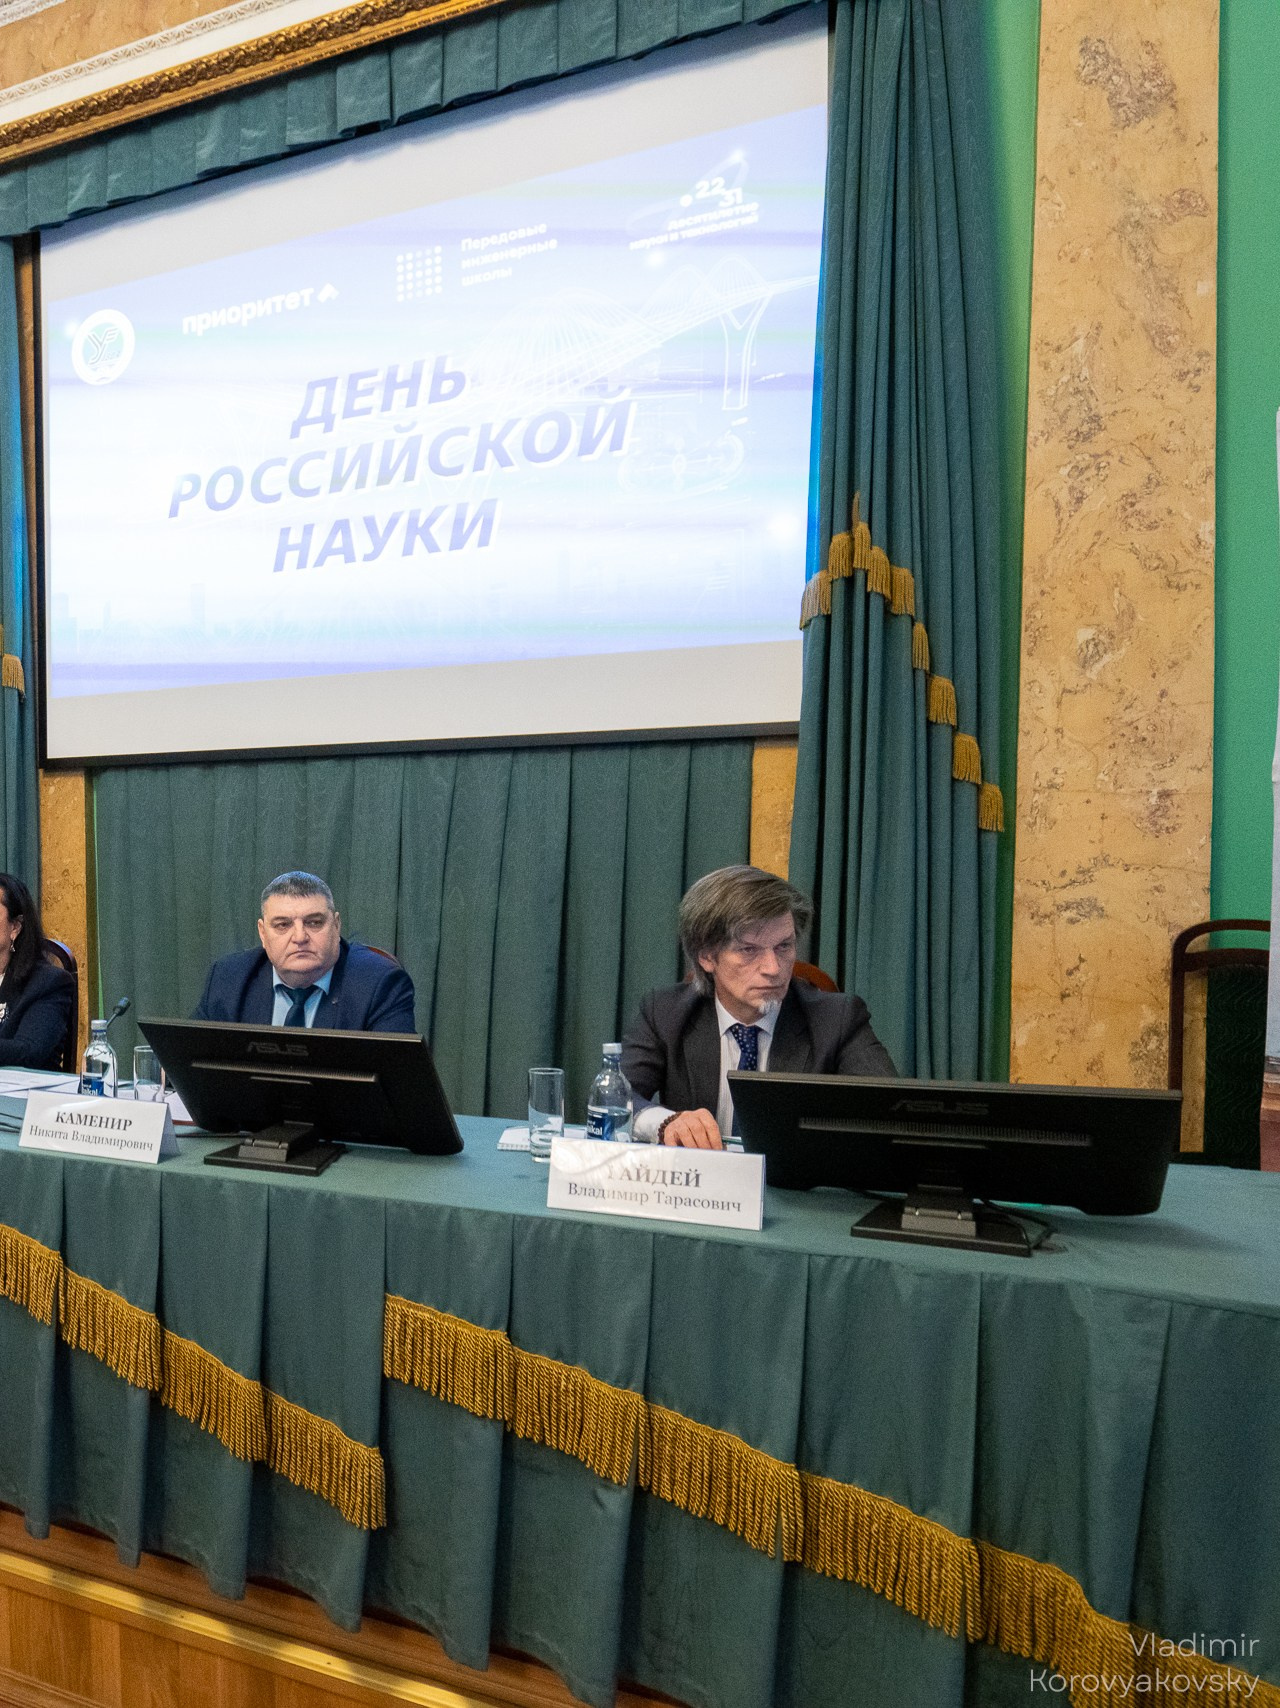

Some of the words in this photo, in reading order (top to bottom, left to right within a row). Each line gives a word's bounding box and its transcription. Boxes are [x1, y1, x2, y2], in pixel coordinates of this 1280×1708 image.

[695, 177, 725, 199] 22
[718, 187, 743, 207] 31
[461, 223, 547, 252] Передовые
[461, 239, 558, 269] инженерные
[461, 267, 513, 287] школы
[182, 287, 315, 336] приоритет
[289, 355, 469, 439] ДЕНЬ
[168, 388, 634, 519] РОССИЙСКОЙ
[272, 498, 499, 573] НАУКИ
[55, 1111, 133, 1132] КАМЕНИР
[29, 1125, 69, 1141] Никита
[72, 1130, 154, 1151] Владимирович
[568, 1182, 649, 1205] Владимир
[654, 1190, 742, 1213] Тарасович
